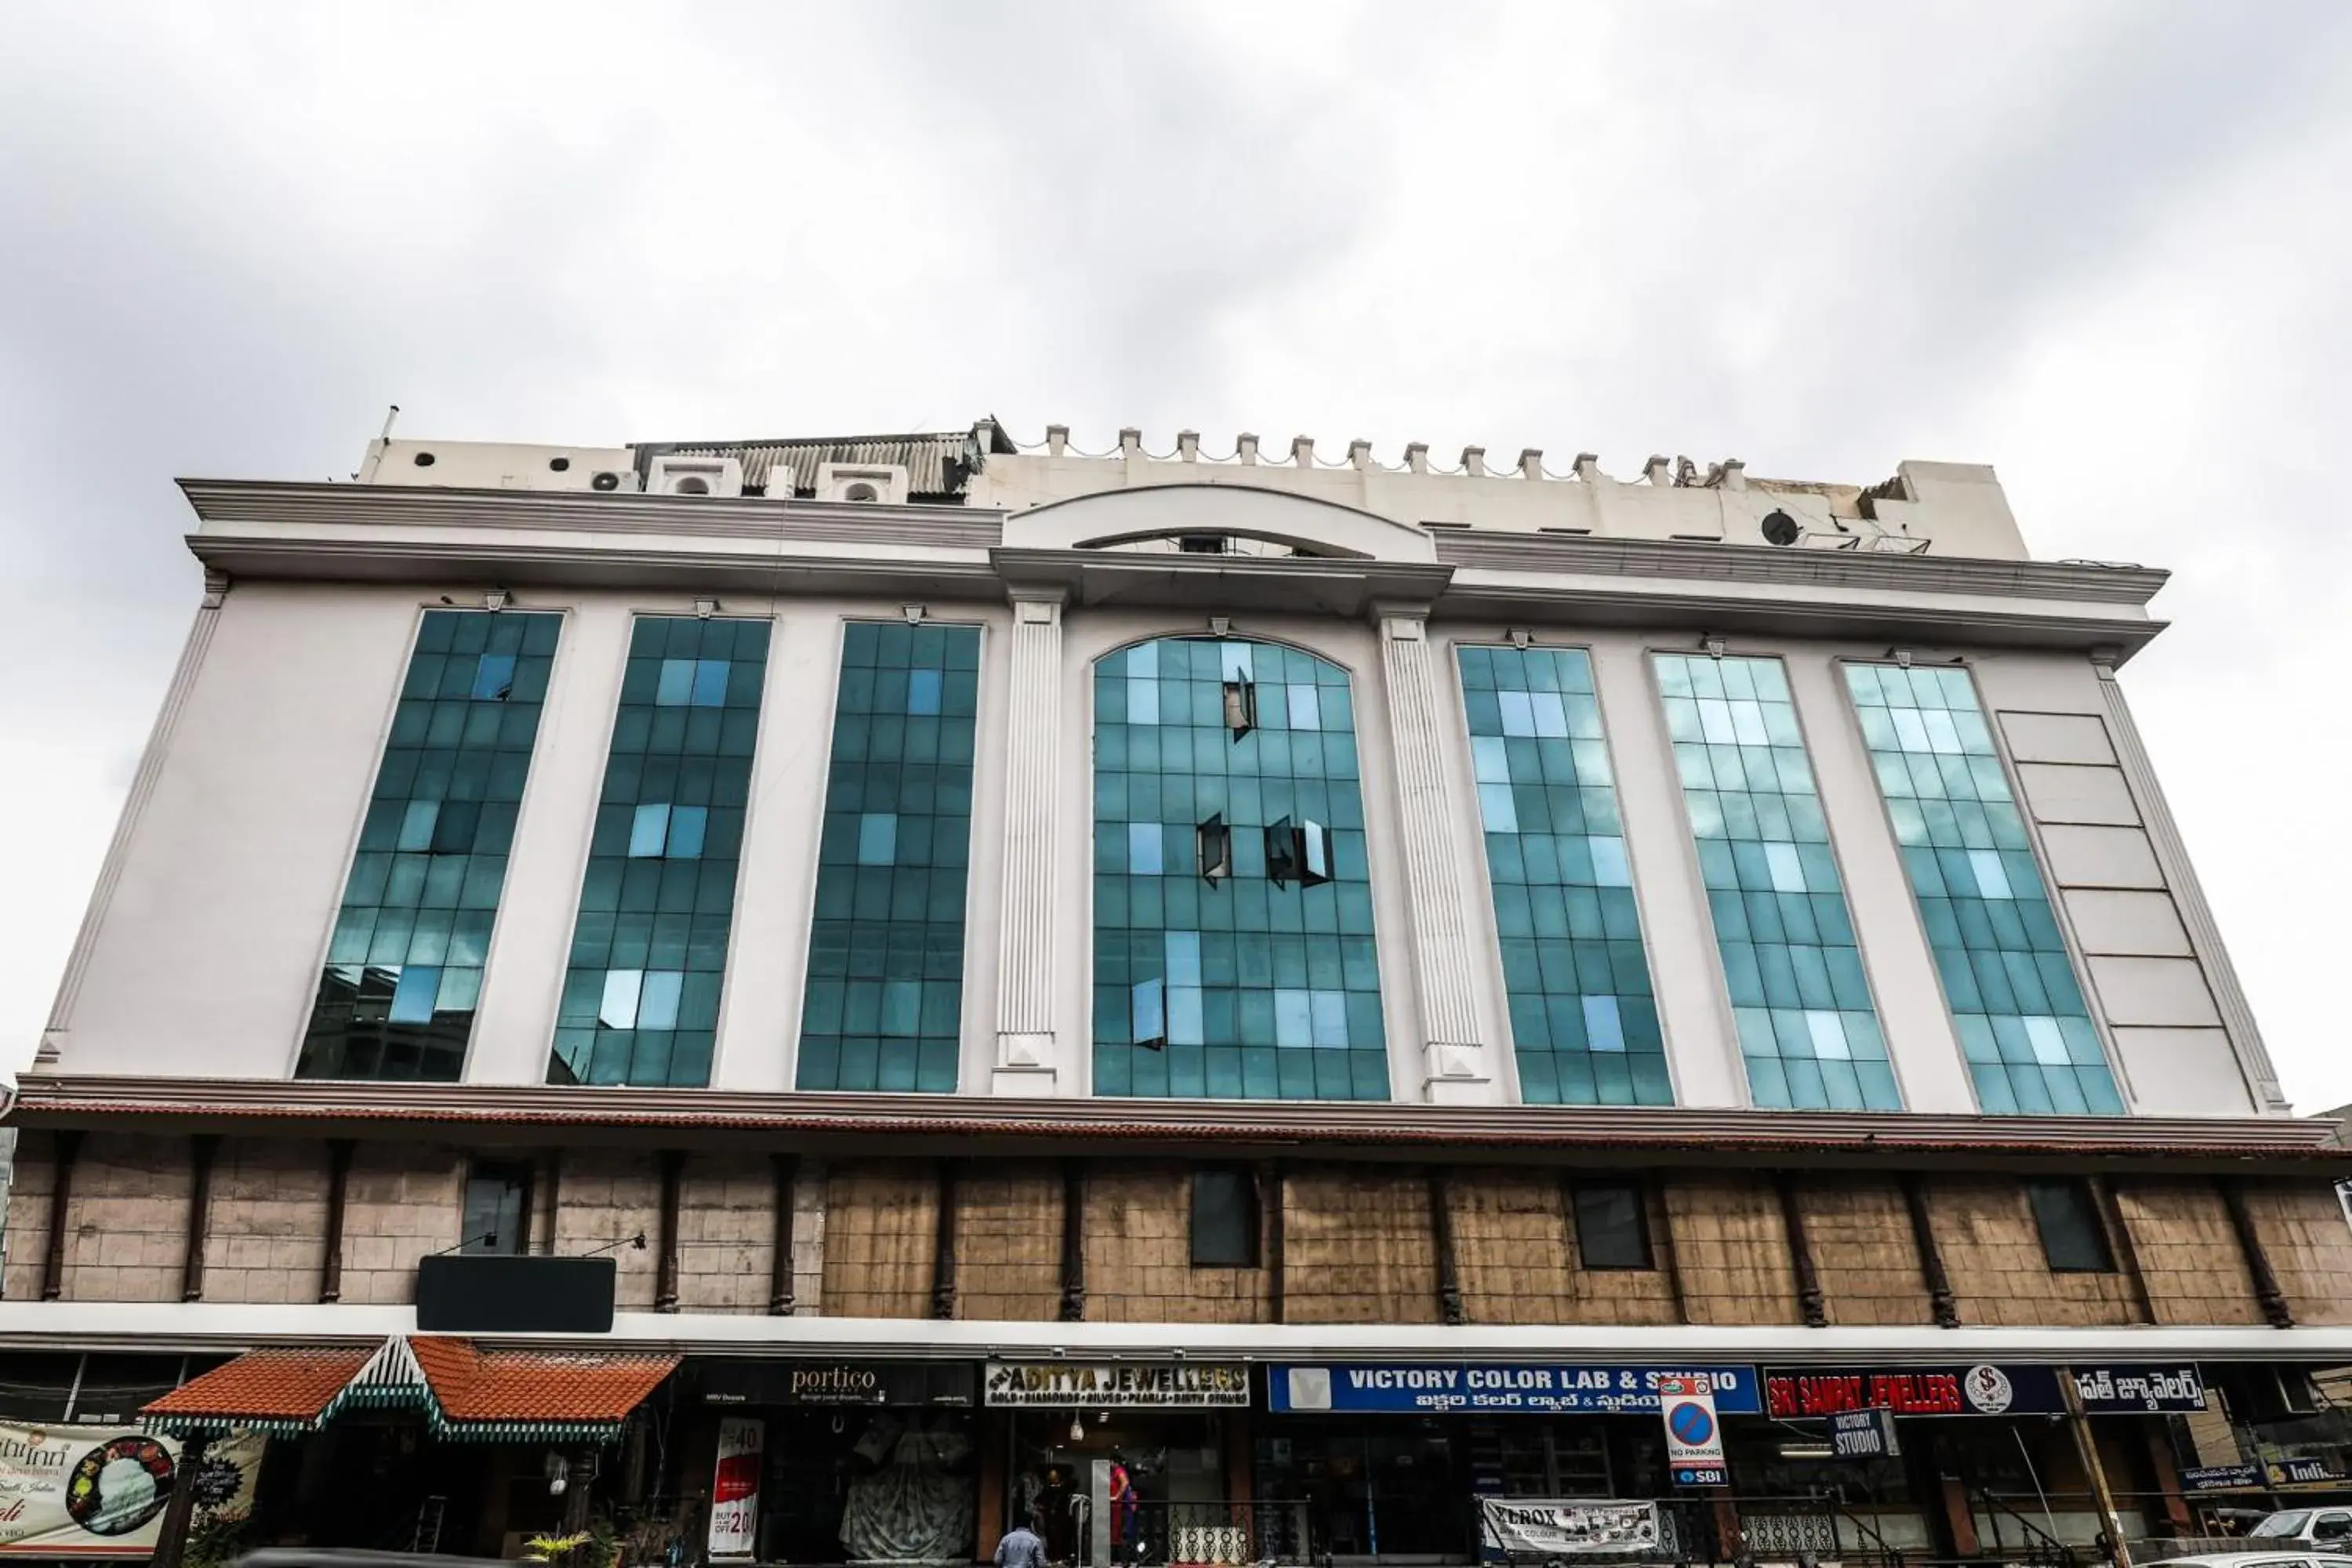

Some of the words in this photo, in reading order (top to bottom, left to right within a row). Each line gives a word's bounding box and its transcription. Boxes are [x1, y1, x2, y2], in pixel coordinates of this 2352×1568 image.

[791, 1366, 876, 1392] portico
[1009, 1367, 1097, 1392] ADITYA
[1103, 1367, 1247, 1392] JEWELLERS
[1349, 1370, 1457, 1388] VICTORY
[1467, 1370, 1552, 1389] COLOR
[1561, 1371, 1610, 1389] LAB
[1619, 1371, 1638, 1389] &
[990, 1392, 1018, 1403] GOLD
[1025, 1392, 1080, 1403] DIAMONDS
[1087, 1392, 1123, 1403] SILVER
[1472, 1393, 1522, 1406] కలర్
[1527, 1393, 1578, 1410] ల్యాబ్
[1583, 1396, 1594, 1407] &
[1768, 1377, 1797, 1416] SRI
[1799, 1376, 1863, 1414] SAMPAT
[1868, 1374, 1964, 1411] JEWELLERS
[1835, 1413, 1871, 1430] VICTORY
[1835, 1429, 1882, 1455] STUDIO
[1671, 1449, 1683, 1457] NO
[1685, 1448, 1722, 1457] PARKING
[1696, 1470, 1722, 1483] SBI
[715, 1512, 731, 1520] BUY
